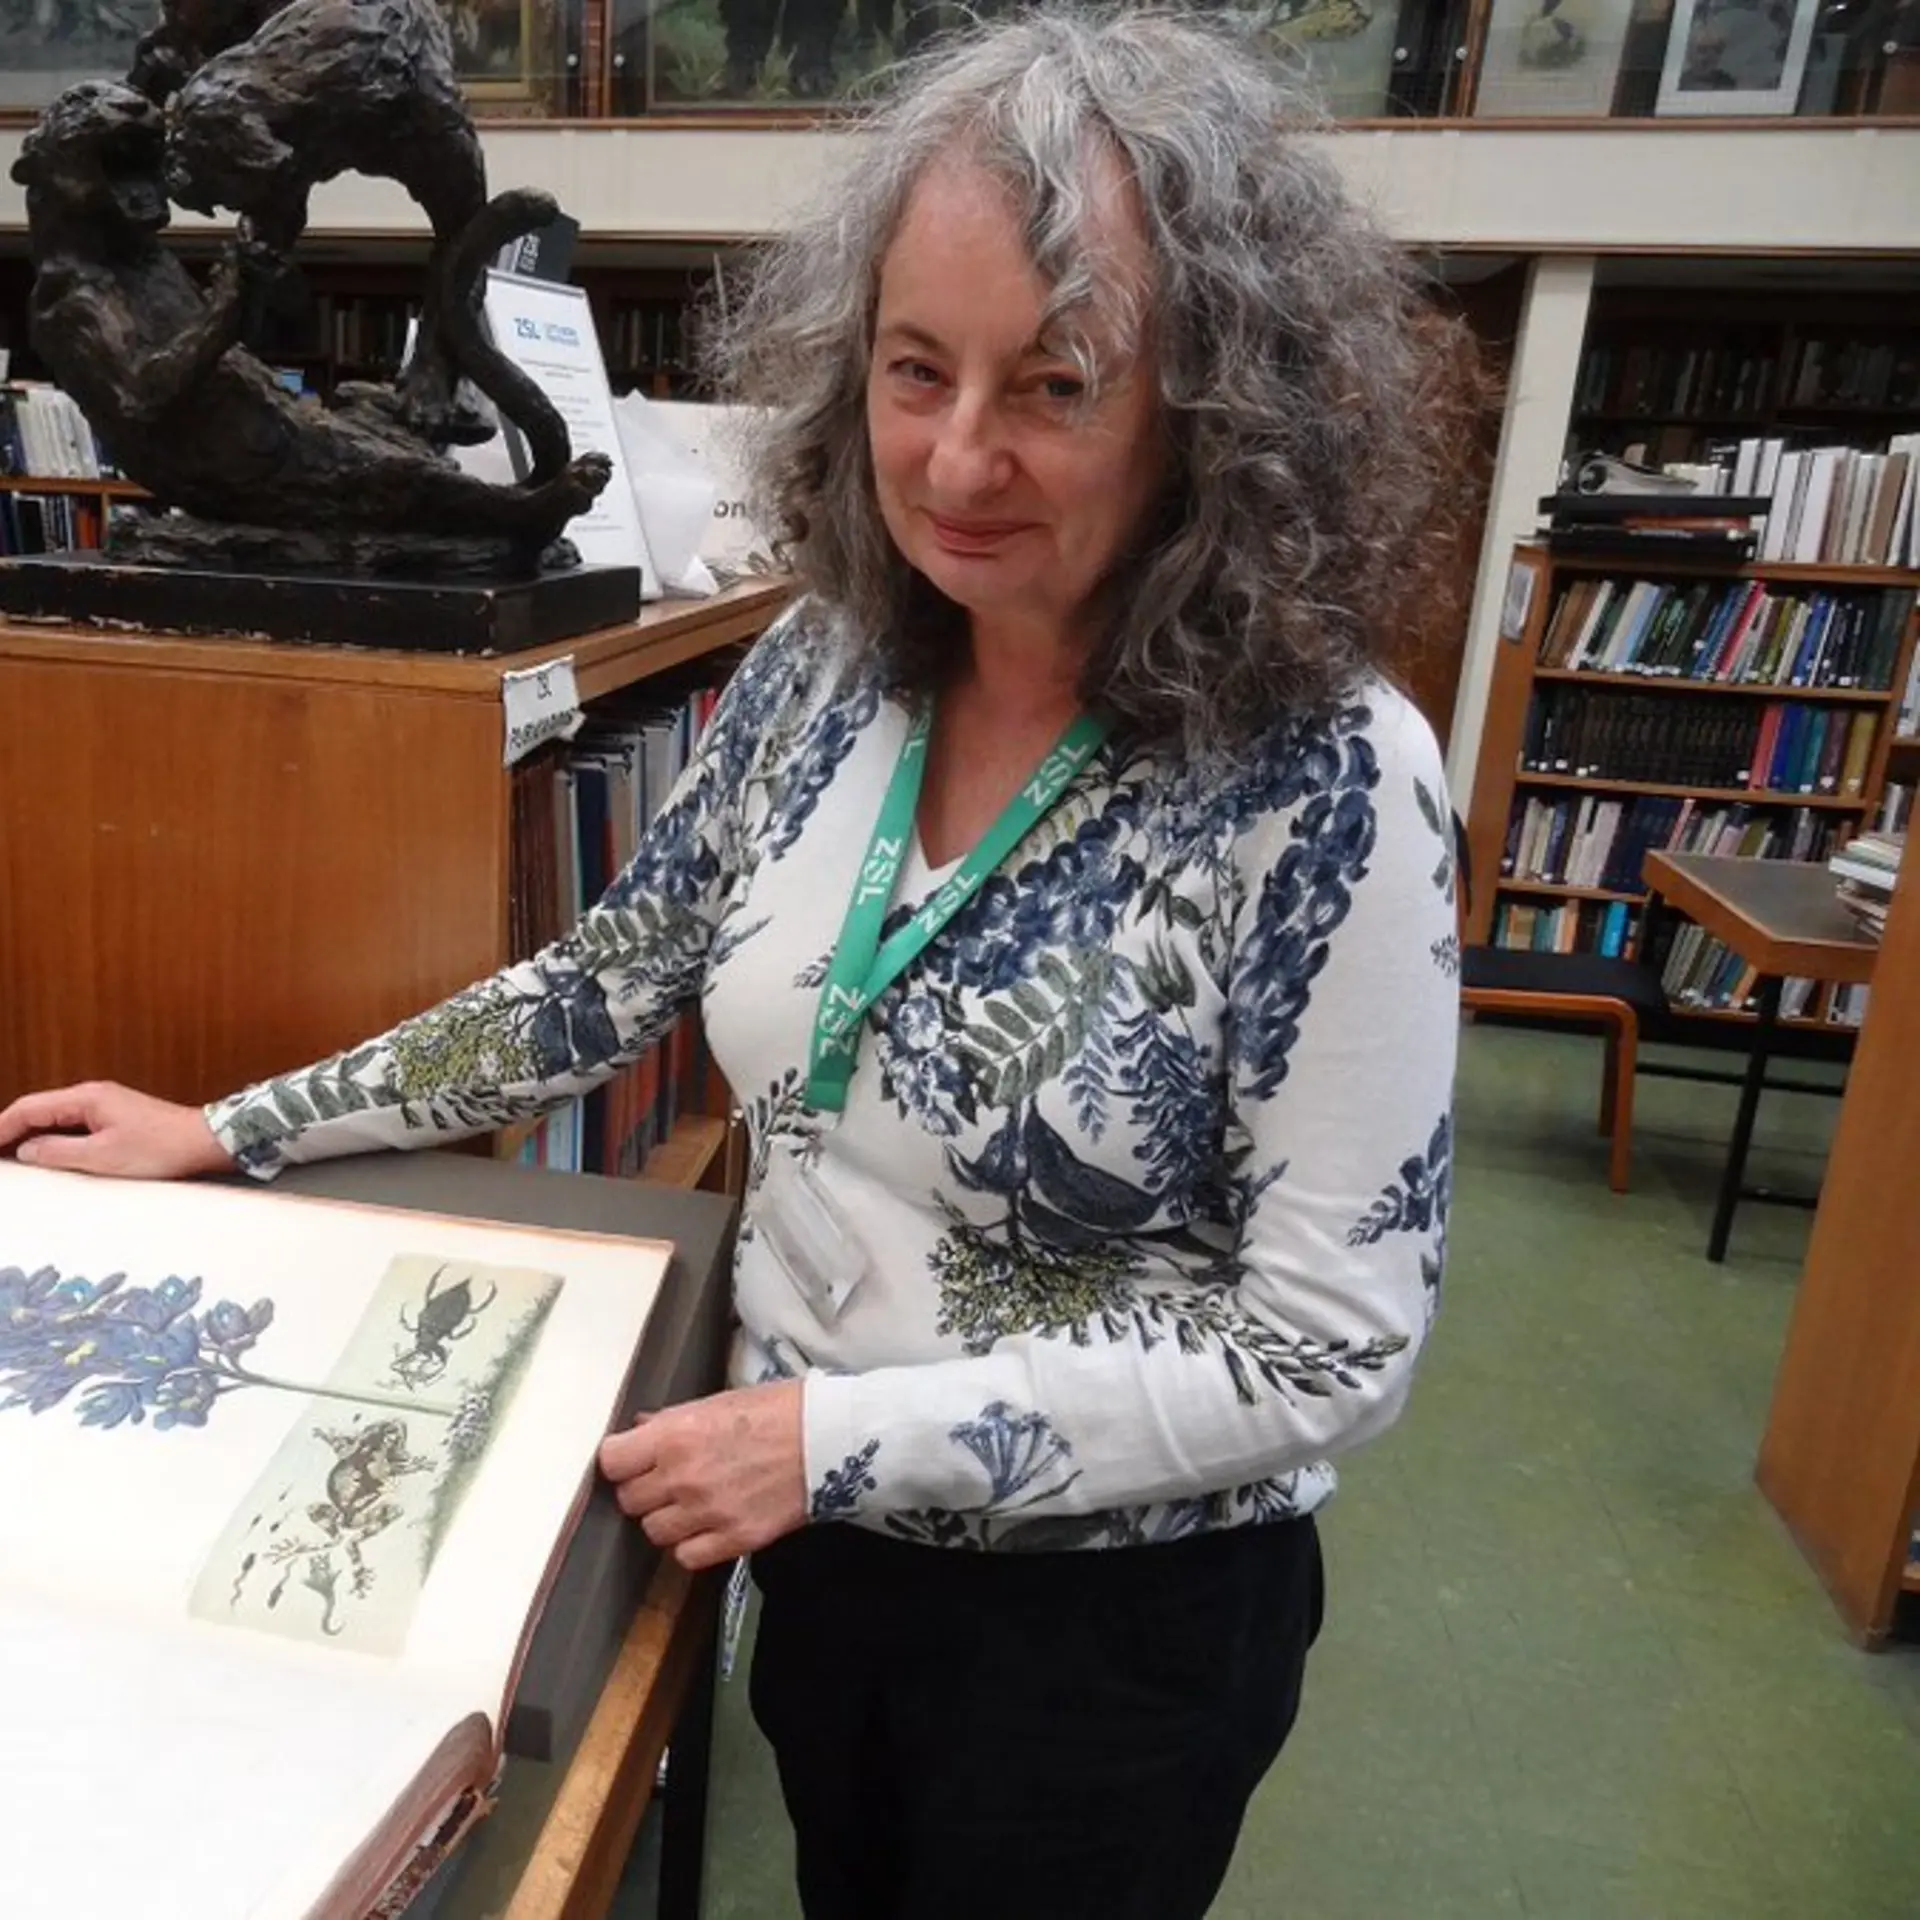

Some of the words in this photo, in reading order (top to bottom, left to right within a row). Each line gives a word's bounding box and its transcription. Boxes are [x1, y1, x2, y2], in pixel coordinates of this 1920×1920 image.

[513, 317, 541, 341] ZSL
[1023, 743, 1091, 808] ZSL
[857, 837, 900, 906] ZSL
[916, 871, 978, 934] ZSL
